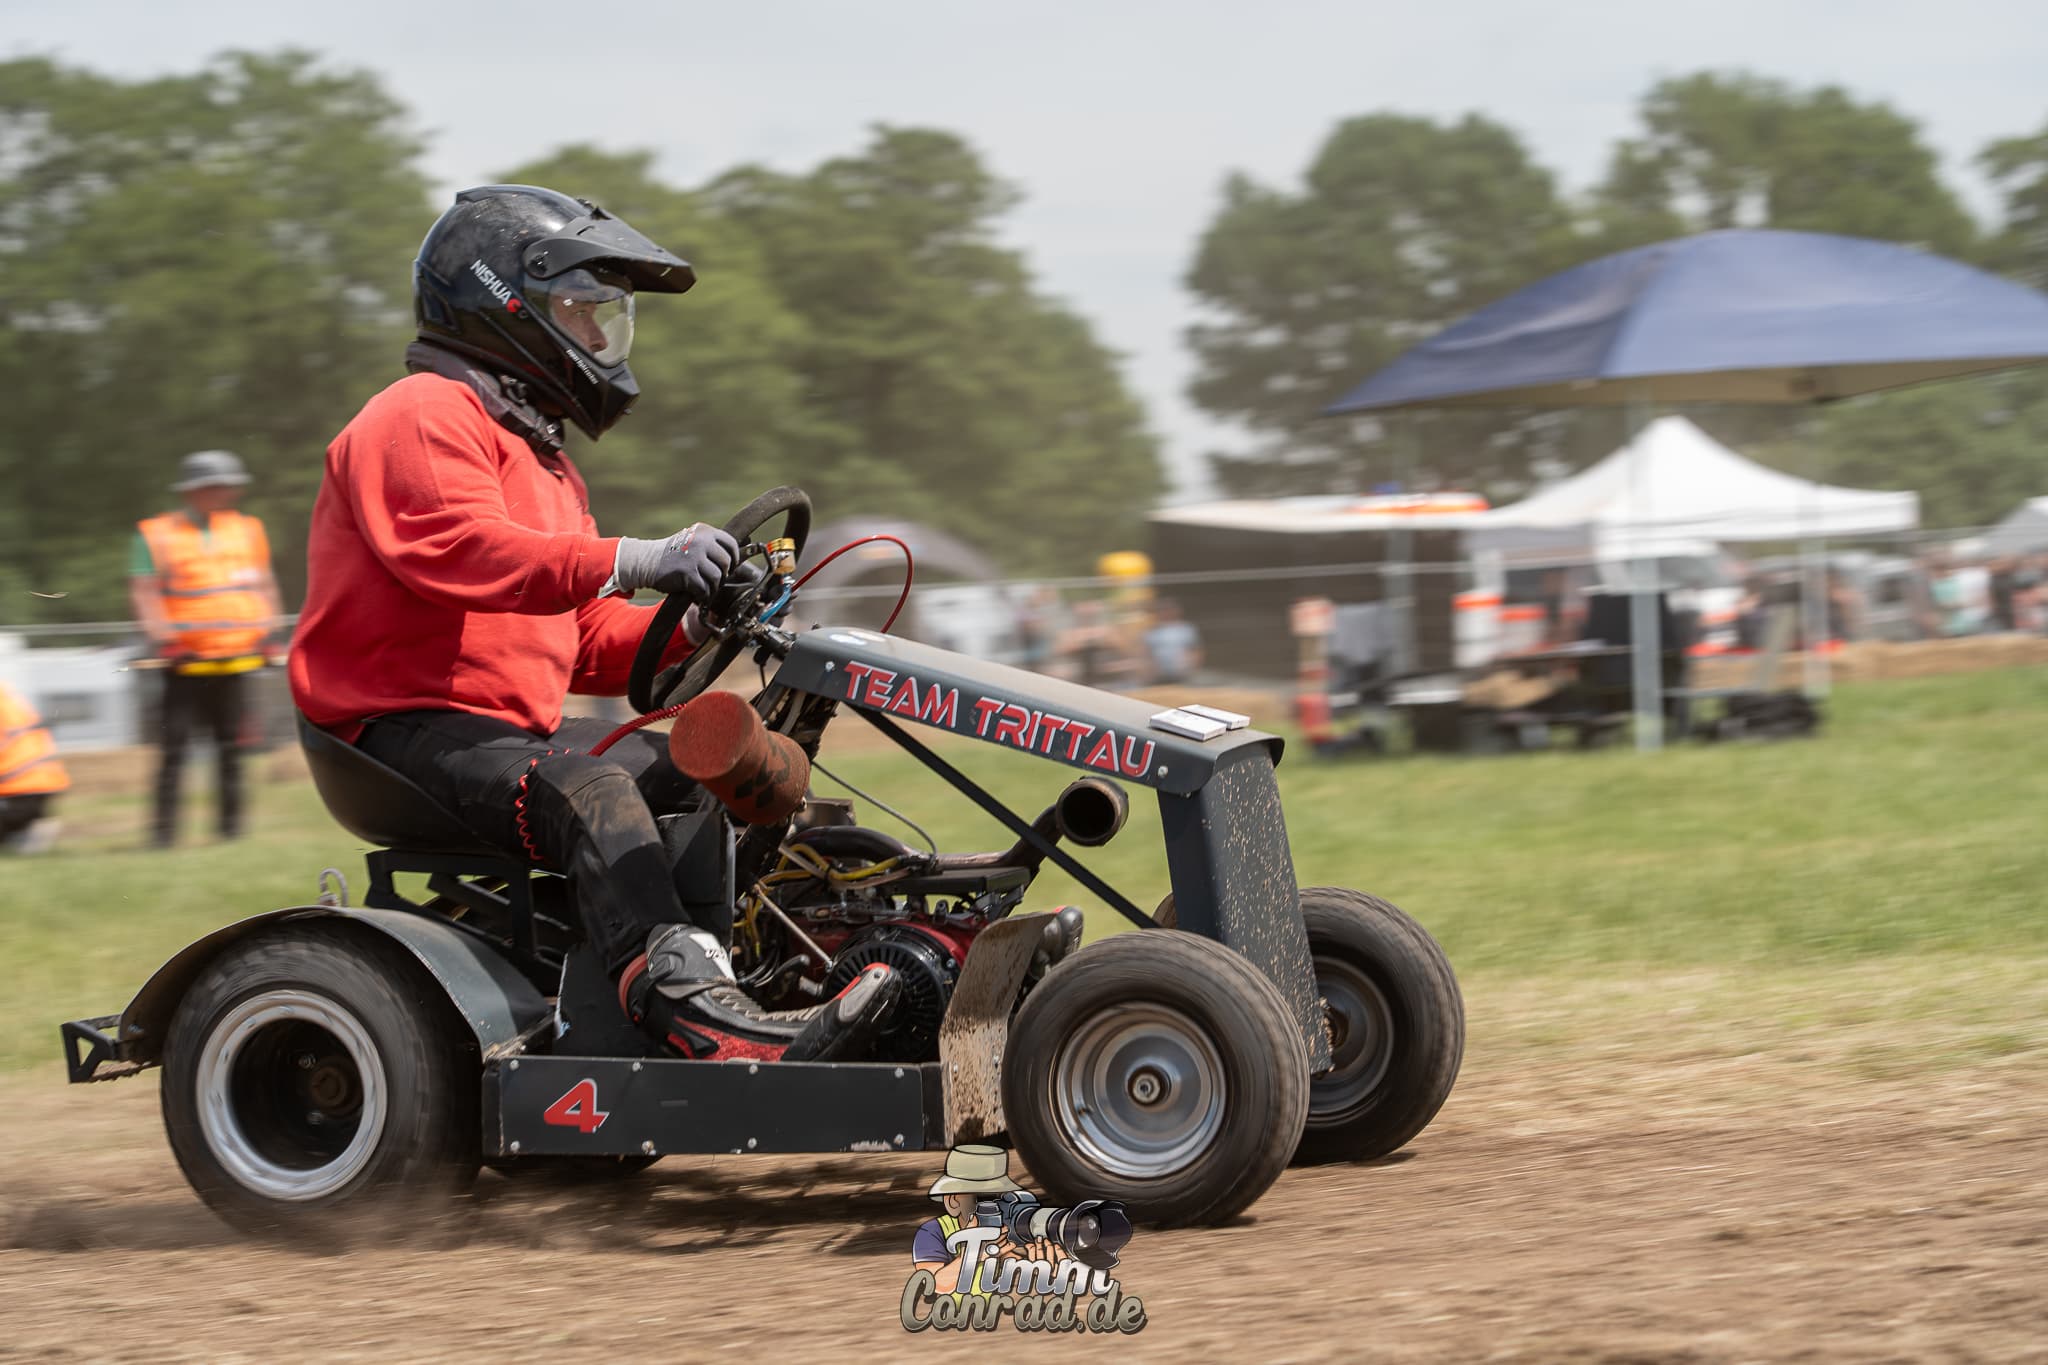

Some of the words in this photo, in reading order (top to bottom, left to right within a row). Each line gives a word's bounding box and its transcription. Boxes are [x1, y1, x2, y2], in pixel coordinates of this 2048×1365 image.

[469, 258, 513, 305] NISHUA
[844, 660, 959, 728] TEAM
[974, 696, 1156, 778] TRITTAU
[543, 1077, 610, 1133] 4
